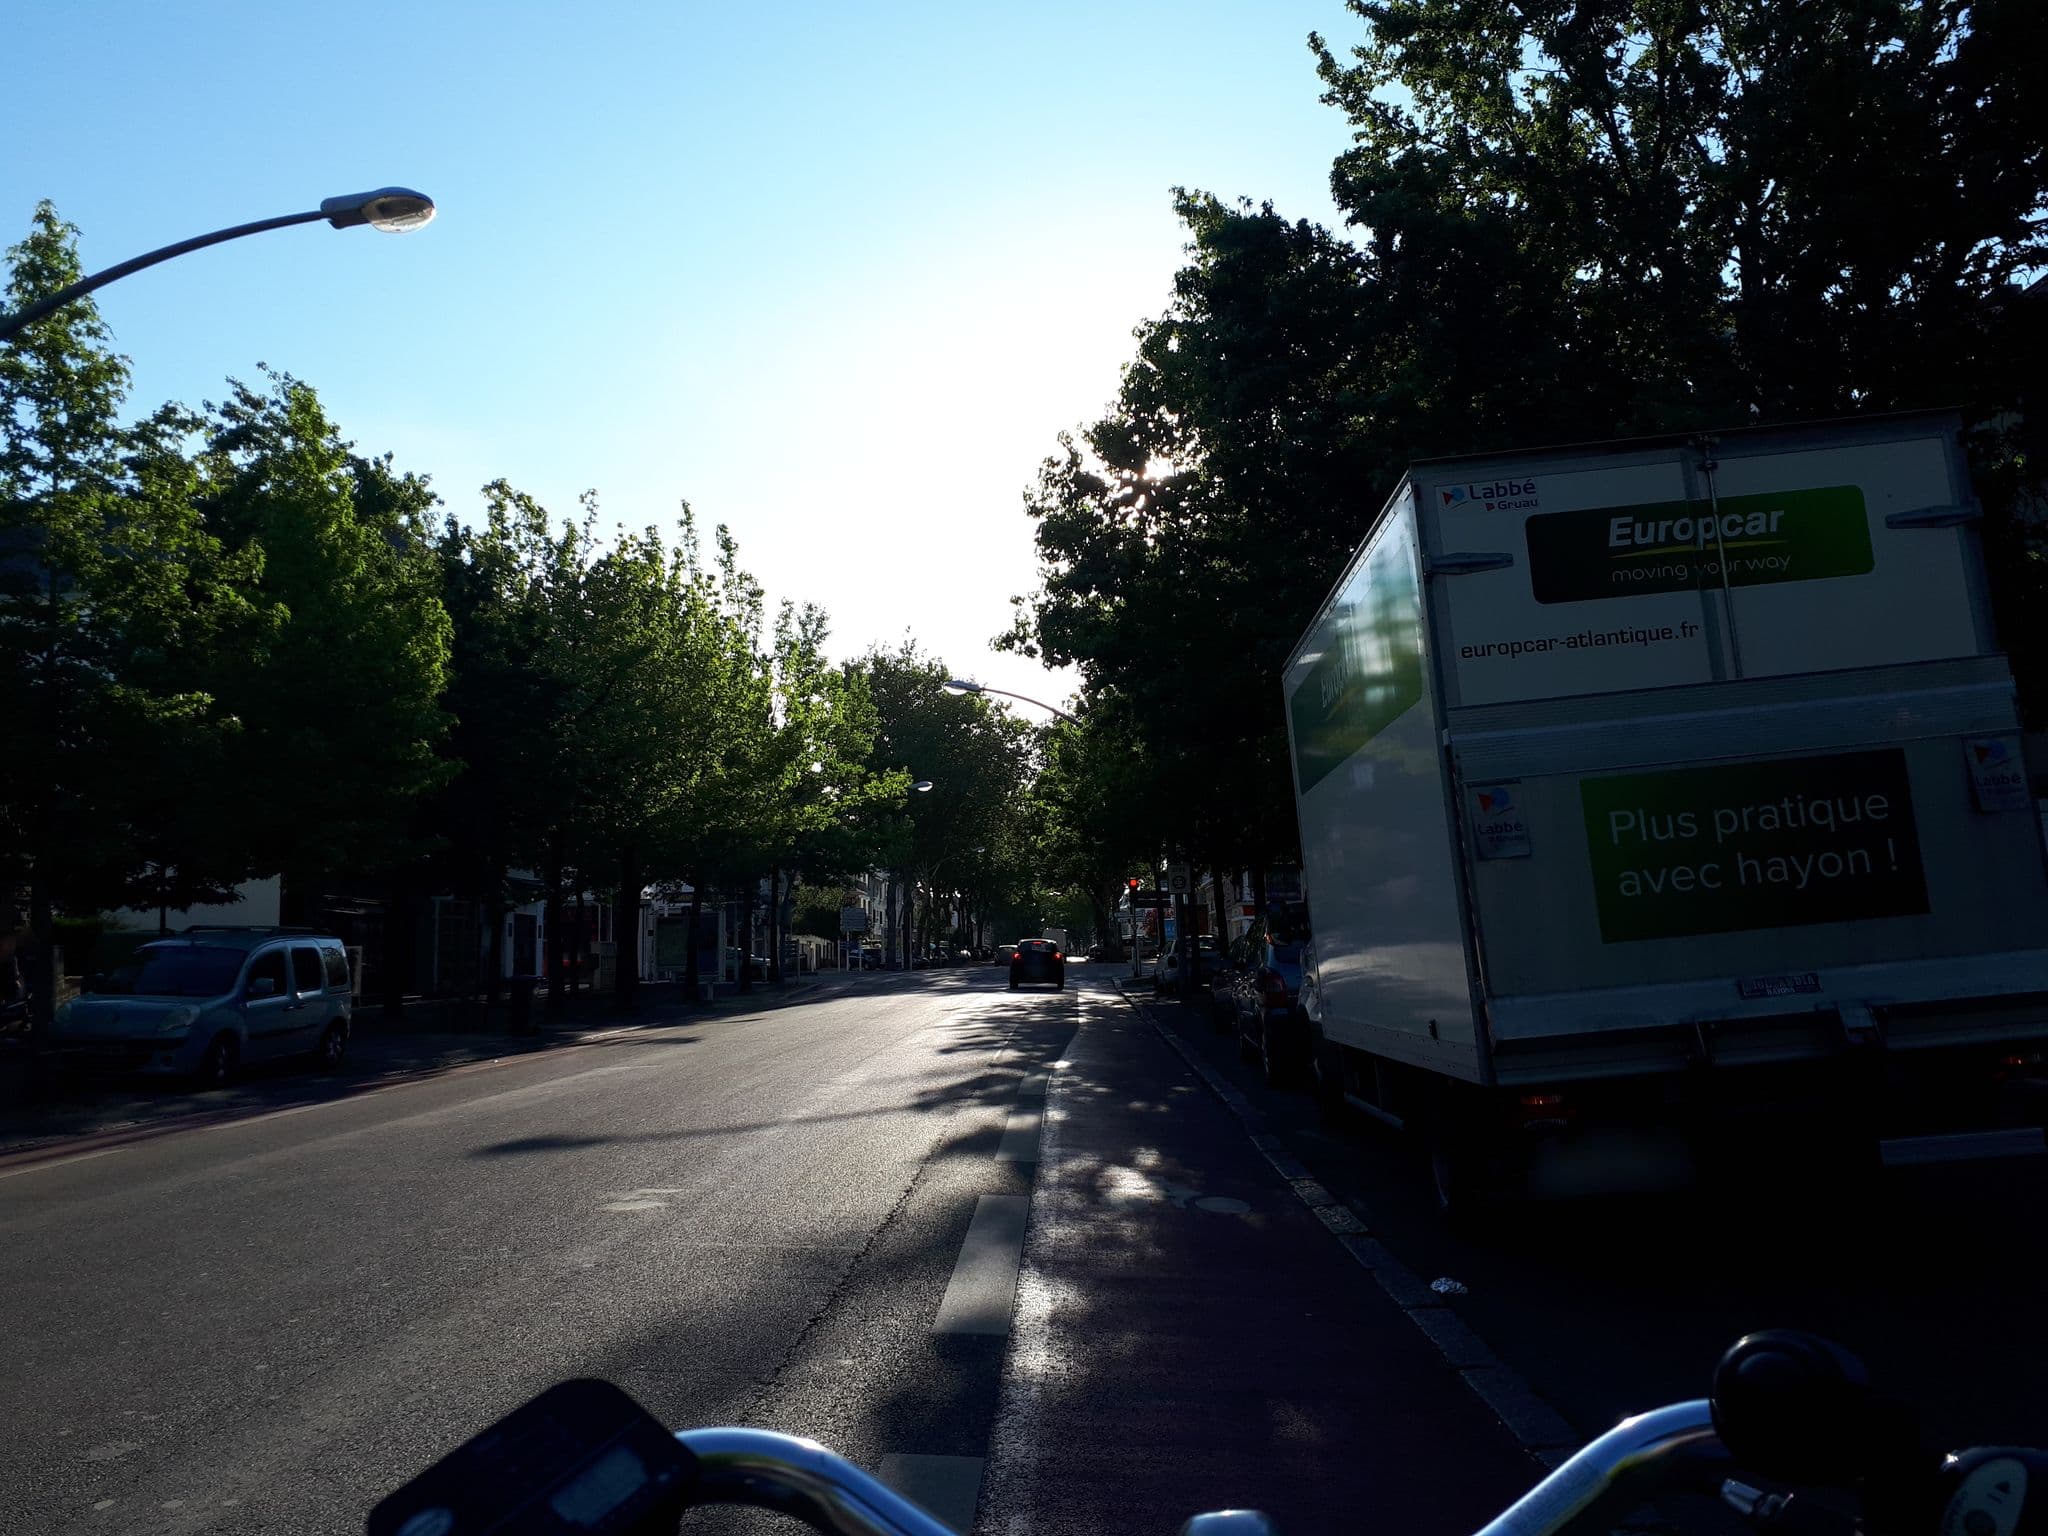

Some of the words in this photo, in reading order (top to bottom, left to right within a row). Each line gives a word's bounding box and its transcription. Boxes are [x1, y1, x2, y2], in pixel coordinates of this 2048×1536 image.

[1468, 479, 1537, 500] Labbé
[1497, 499, 1538, 510] Gruau
[1607, 509, 1787, 549] Europcar
[1610, 560, 1690, 585] moving
[1744, 552, 1793, 576] way
[1461, 621, 1700, 659] europcar-atlantique.fr
[1608, 807, 1699, 845] Plus
[1713, 793, 1889, 844] pratique
[1616, 861, 1723, 897] avec
[1736, 846, 1873, 889] hayon
[1887, 836, 1899, 872] !
